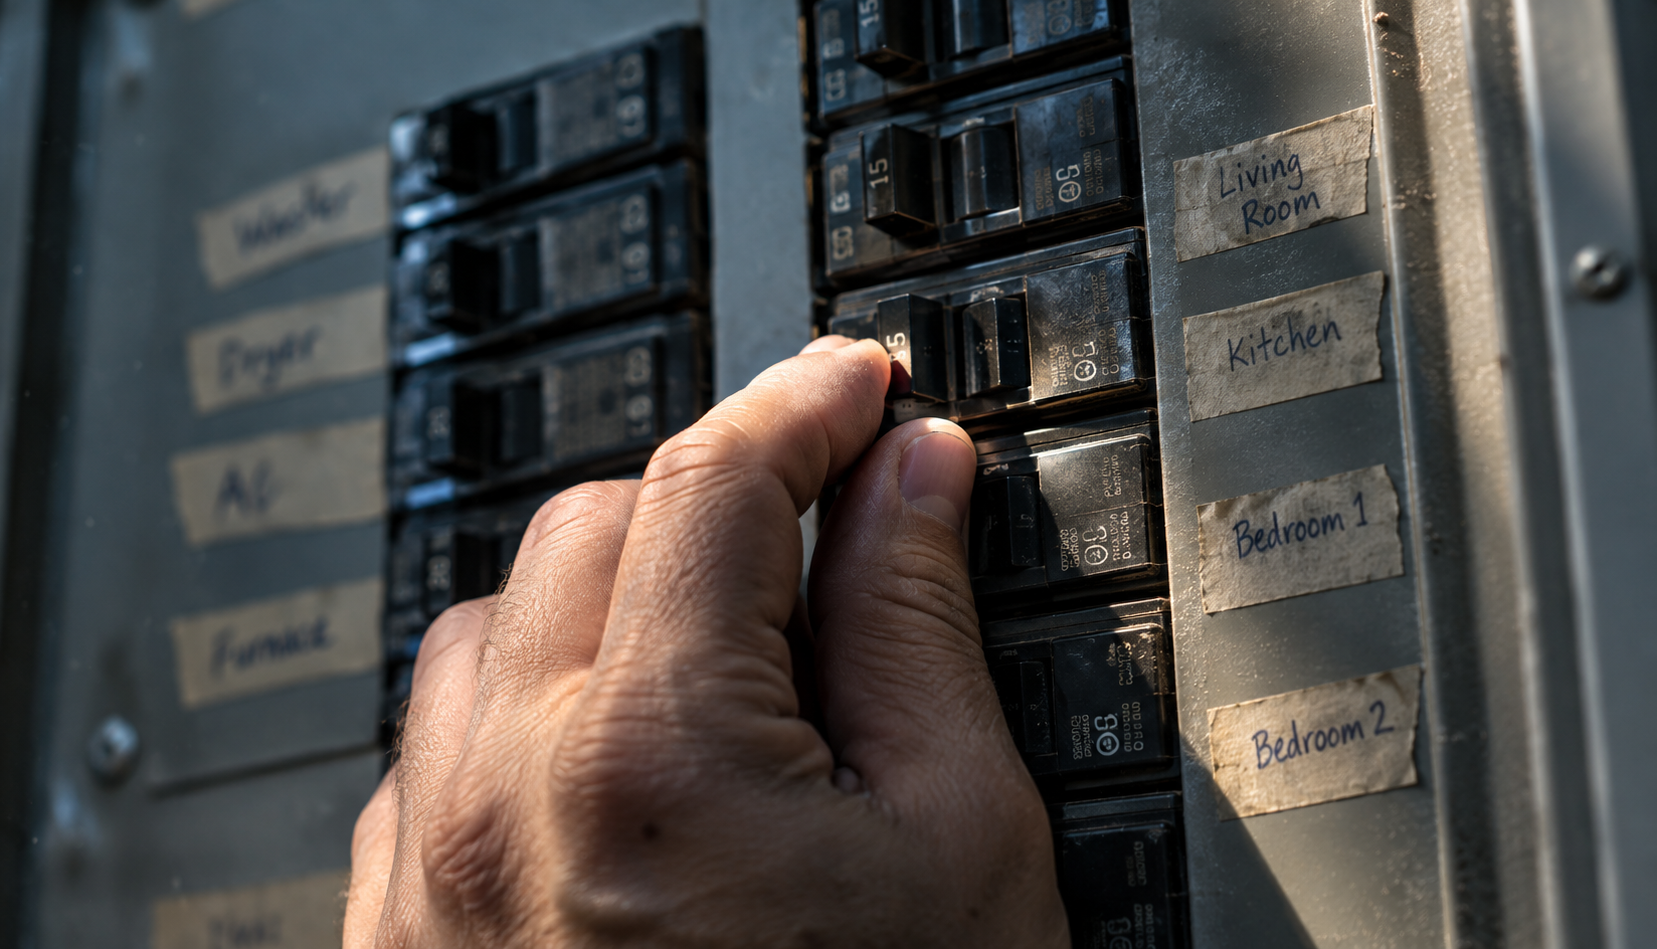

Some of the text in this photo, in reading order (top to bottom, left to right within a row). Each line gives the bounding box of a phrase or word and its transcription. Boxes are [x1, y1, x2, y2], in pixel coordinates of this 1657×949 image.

[869, 158, 889, 189] 15
[1220, 153, 1303, 199] Living
[1241, 191, 1321, 235] Room
[1227, 316, 1342, 372] Kitchen
[1232, 491, 1368, 559] Bedroom 1
[1252, 699, 1394, 769] Bedroom 2
